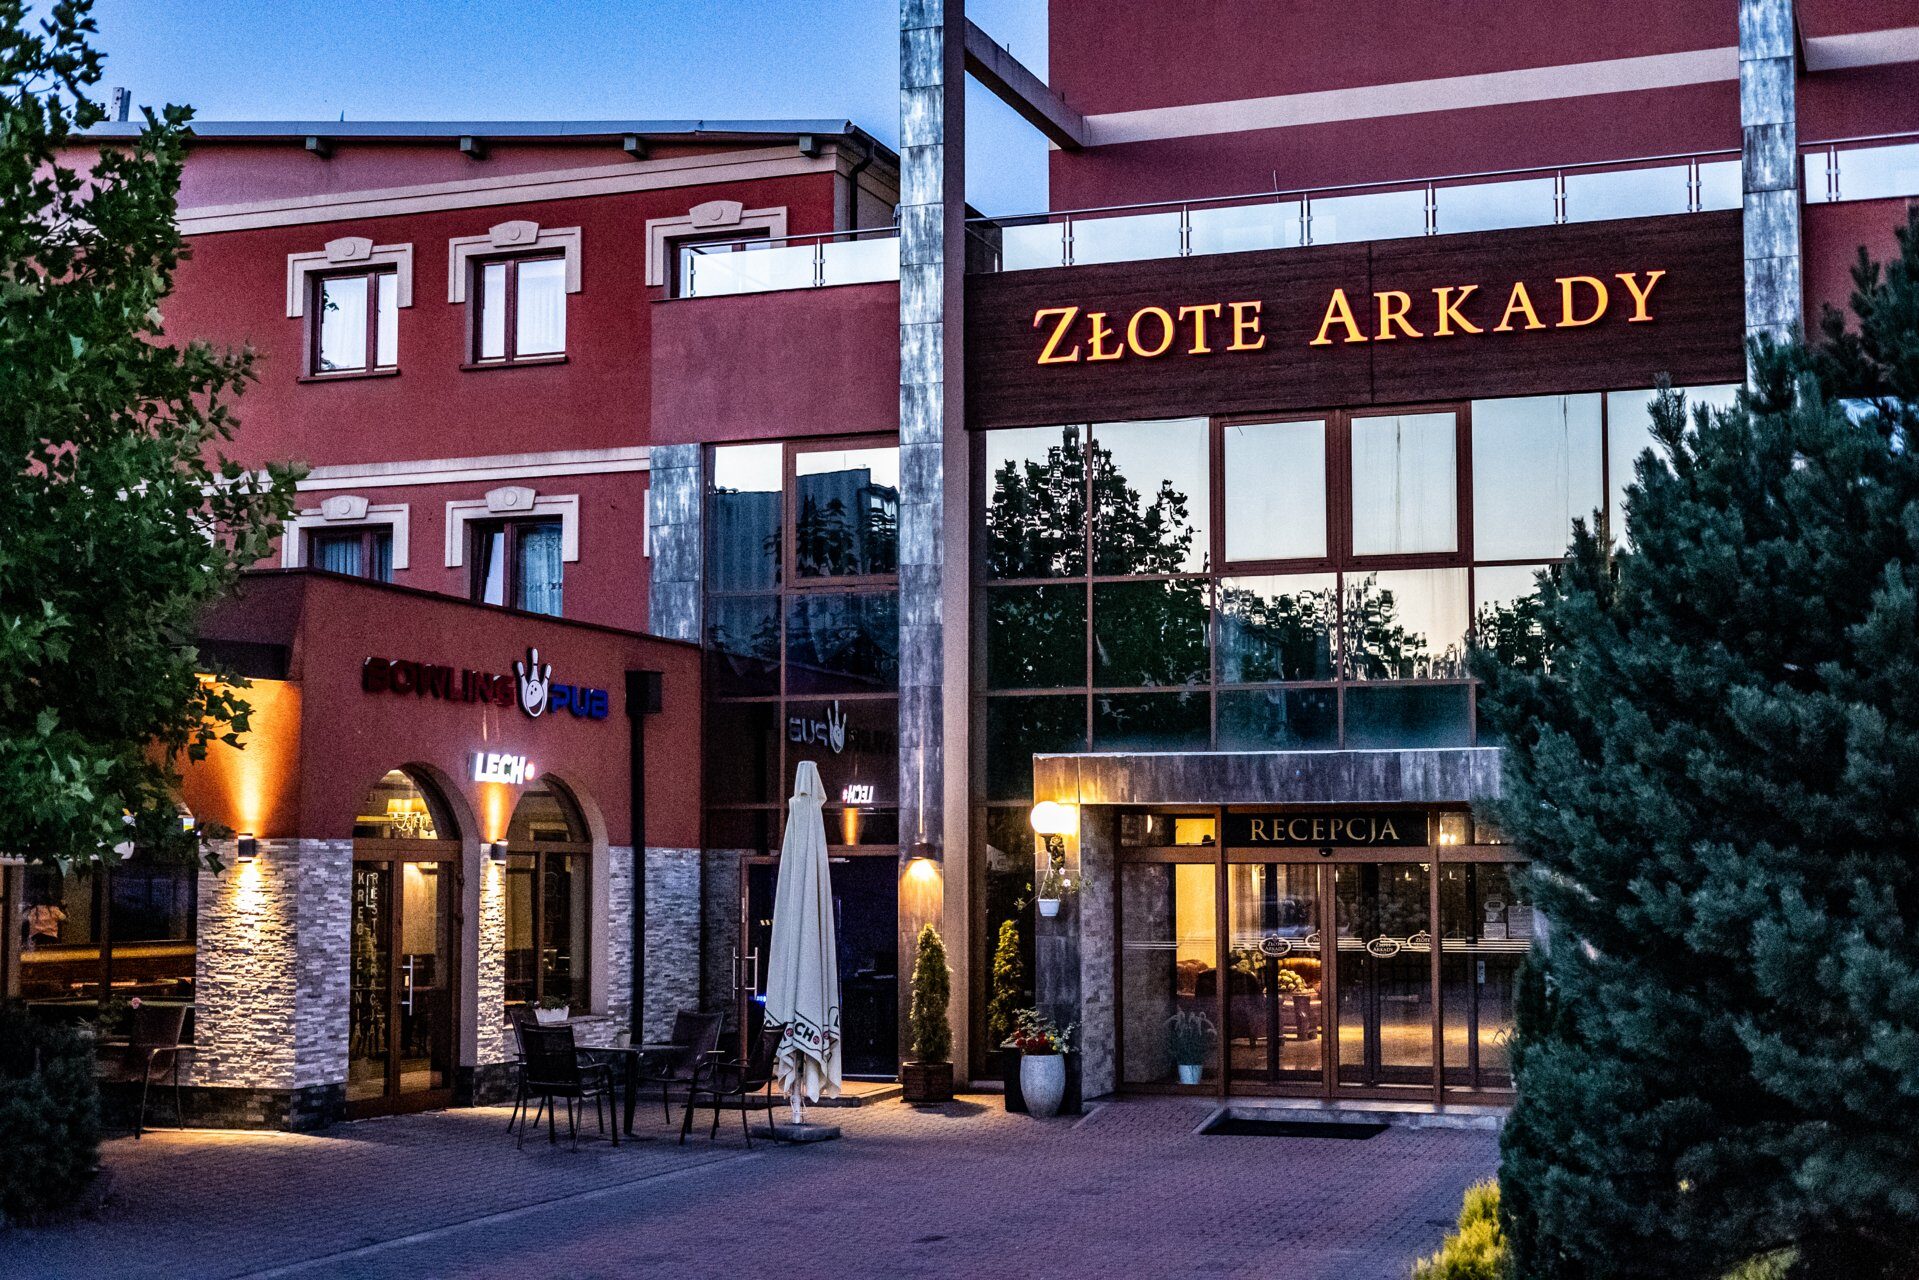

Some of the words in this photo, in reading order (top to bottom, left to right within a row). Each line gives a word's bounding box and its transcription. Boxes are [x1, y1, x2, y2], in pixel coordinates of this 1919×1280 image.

[1033, 300, 1266, 365] ZŁOTE
[1309, 270, 1666, 346] ARKADY
[362, 656, 515, 706] BOWLING
[549, 683, 609, 719] PUB
[475, 752, 526, 784] LECH
[1250, 817, 1400, 843] RECEPCJA
[794, 1022, 815, 1042] CH
